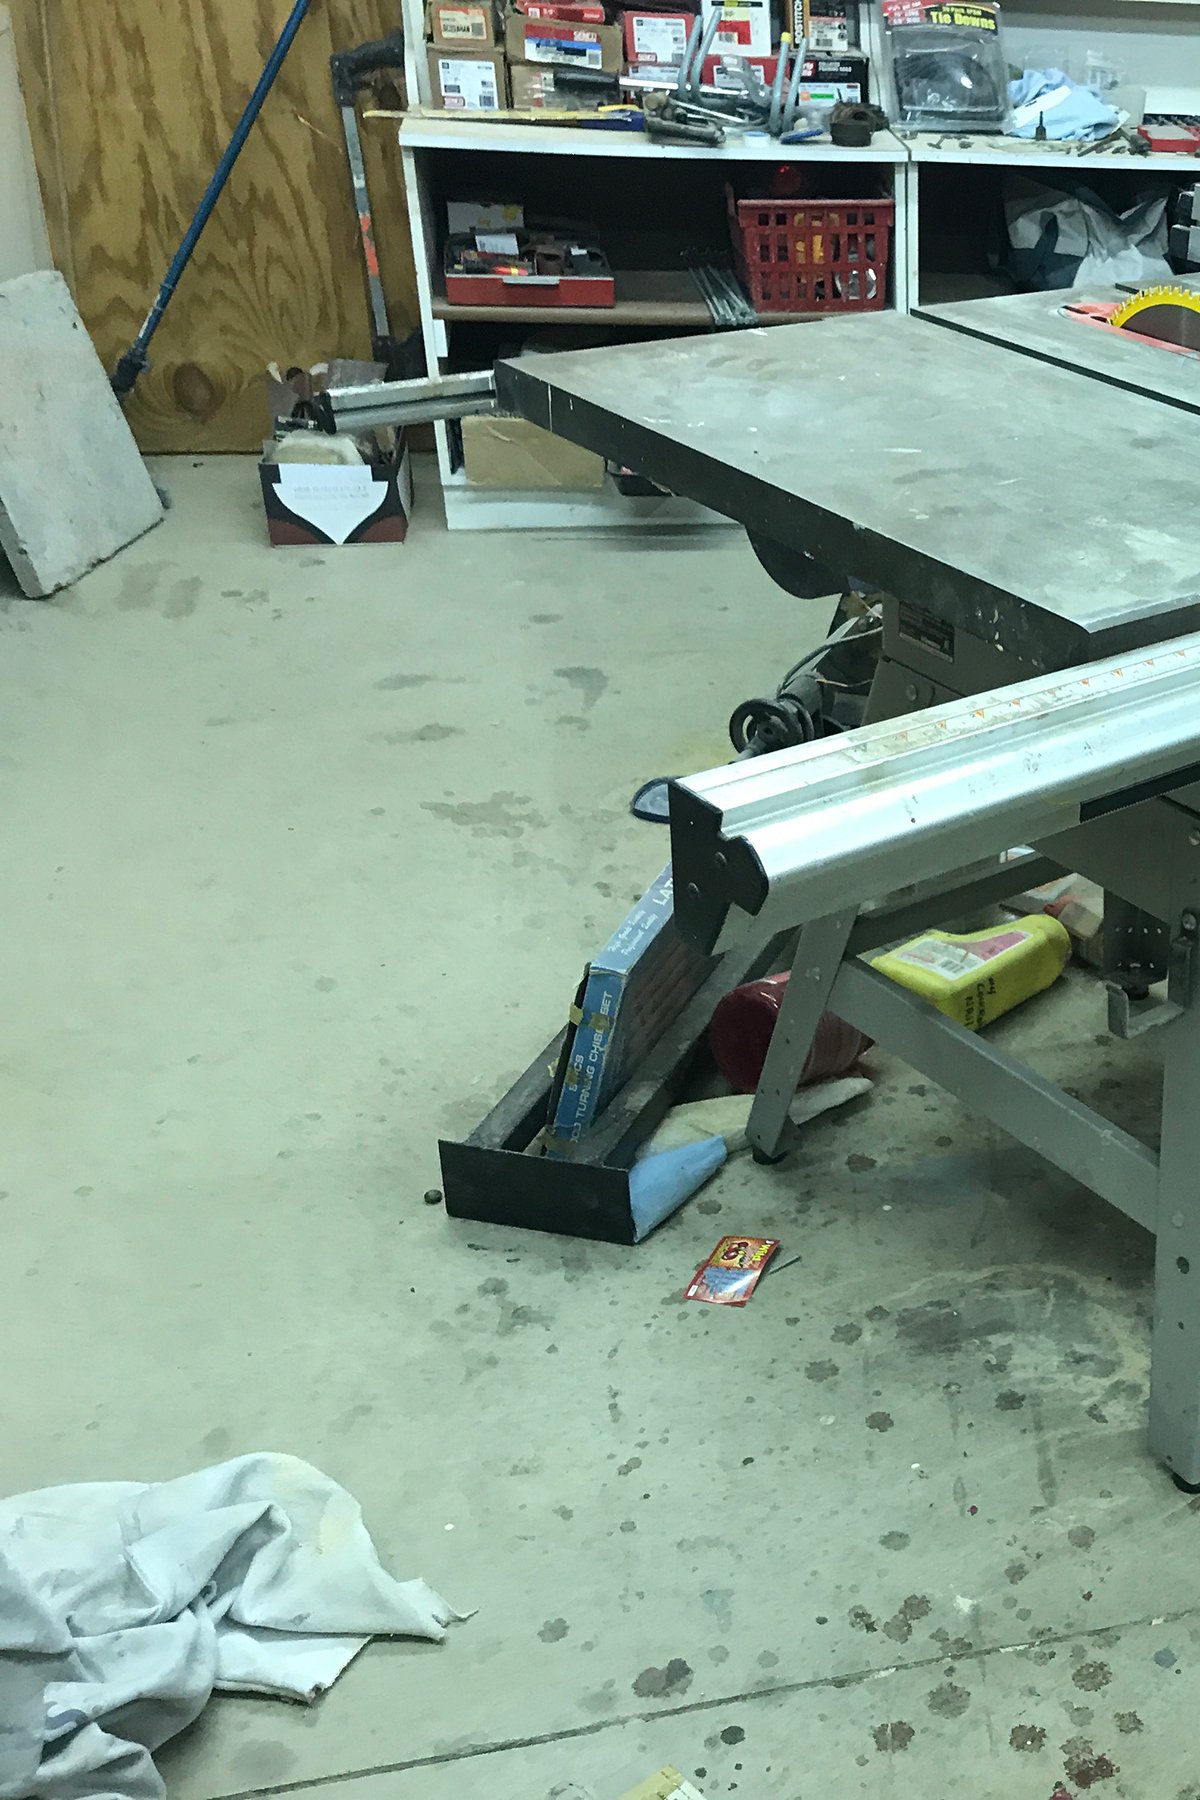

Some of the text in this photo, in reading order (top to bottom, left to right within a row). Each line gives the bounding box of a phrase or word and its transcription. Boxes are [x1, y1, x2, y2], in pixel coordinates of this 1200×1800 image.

[794, 0, 804, 44] BOSTITC
[652, 877, 674, 906] LAT
[575, 1065, 596, 1118] TURNING
[588, 1026, 606, 1062] CHISE
[600, 990, 613, 1015] SET
